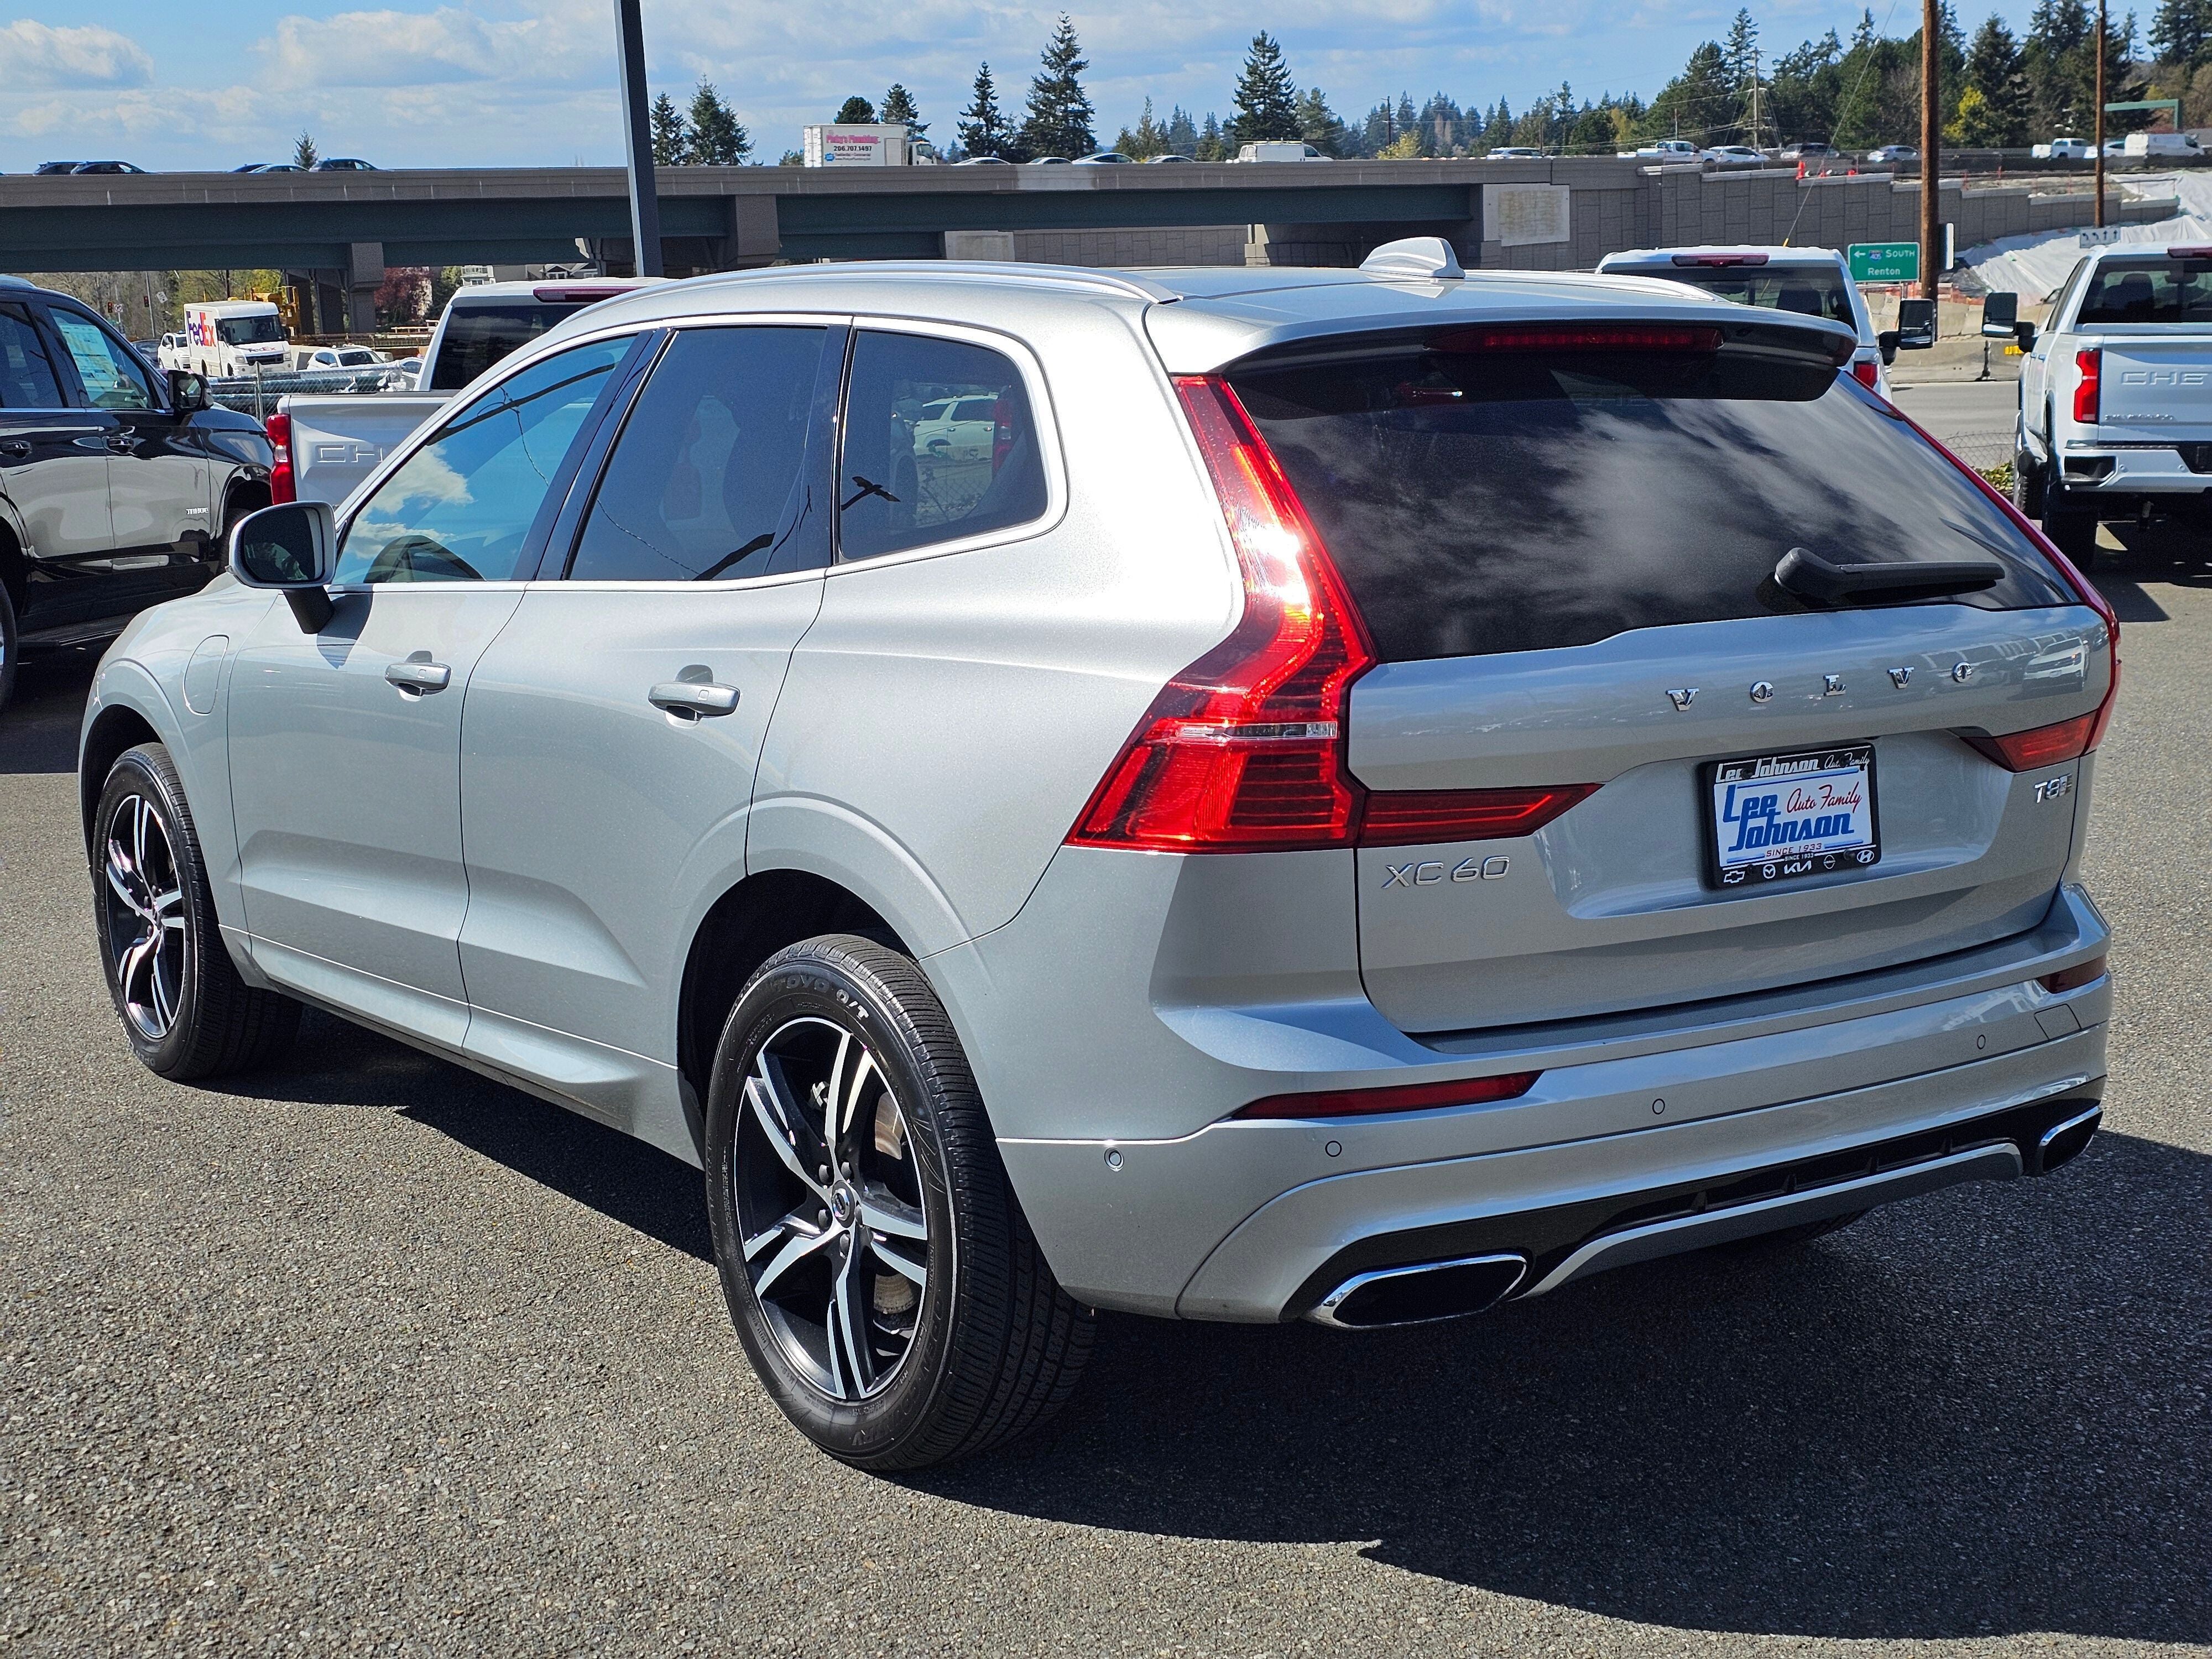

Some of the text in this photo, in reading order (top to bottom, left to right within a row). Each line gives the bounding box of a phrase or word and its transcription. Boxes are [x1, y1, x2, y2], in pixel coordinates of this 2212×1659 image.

[1885, 249, 1916, 258] SOUTH
[1867, 267, 1901, 276] Renton
[186, 311, 217, 348] FedEx
[1666, 661, 1973, 711] VOLVO
[1750, 757, 1820, 778] Johnson
[1824, 754, 1843, 769] Aut
[1723, 784, 1781, 823] Lee
[1787, 781, 1862, 813] Auto Family
[1728, 812, 1854, 852] Johnson
[1765, 843, 1822, 857] SINCE 1933
